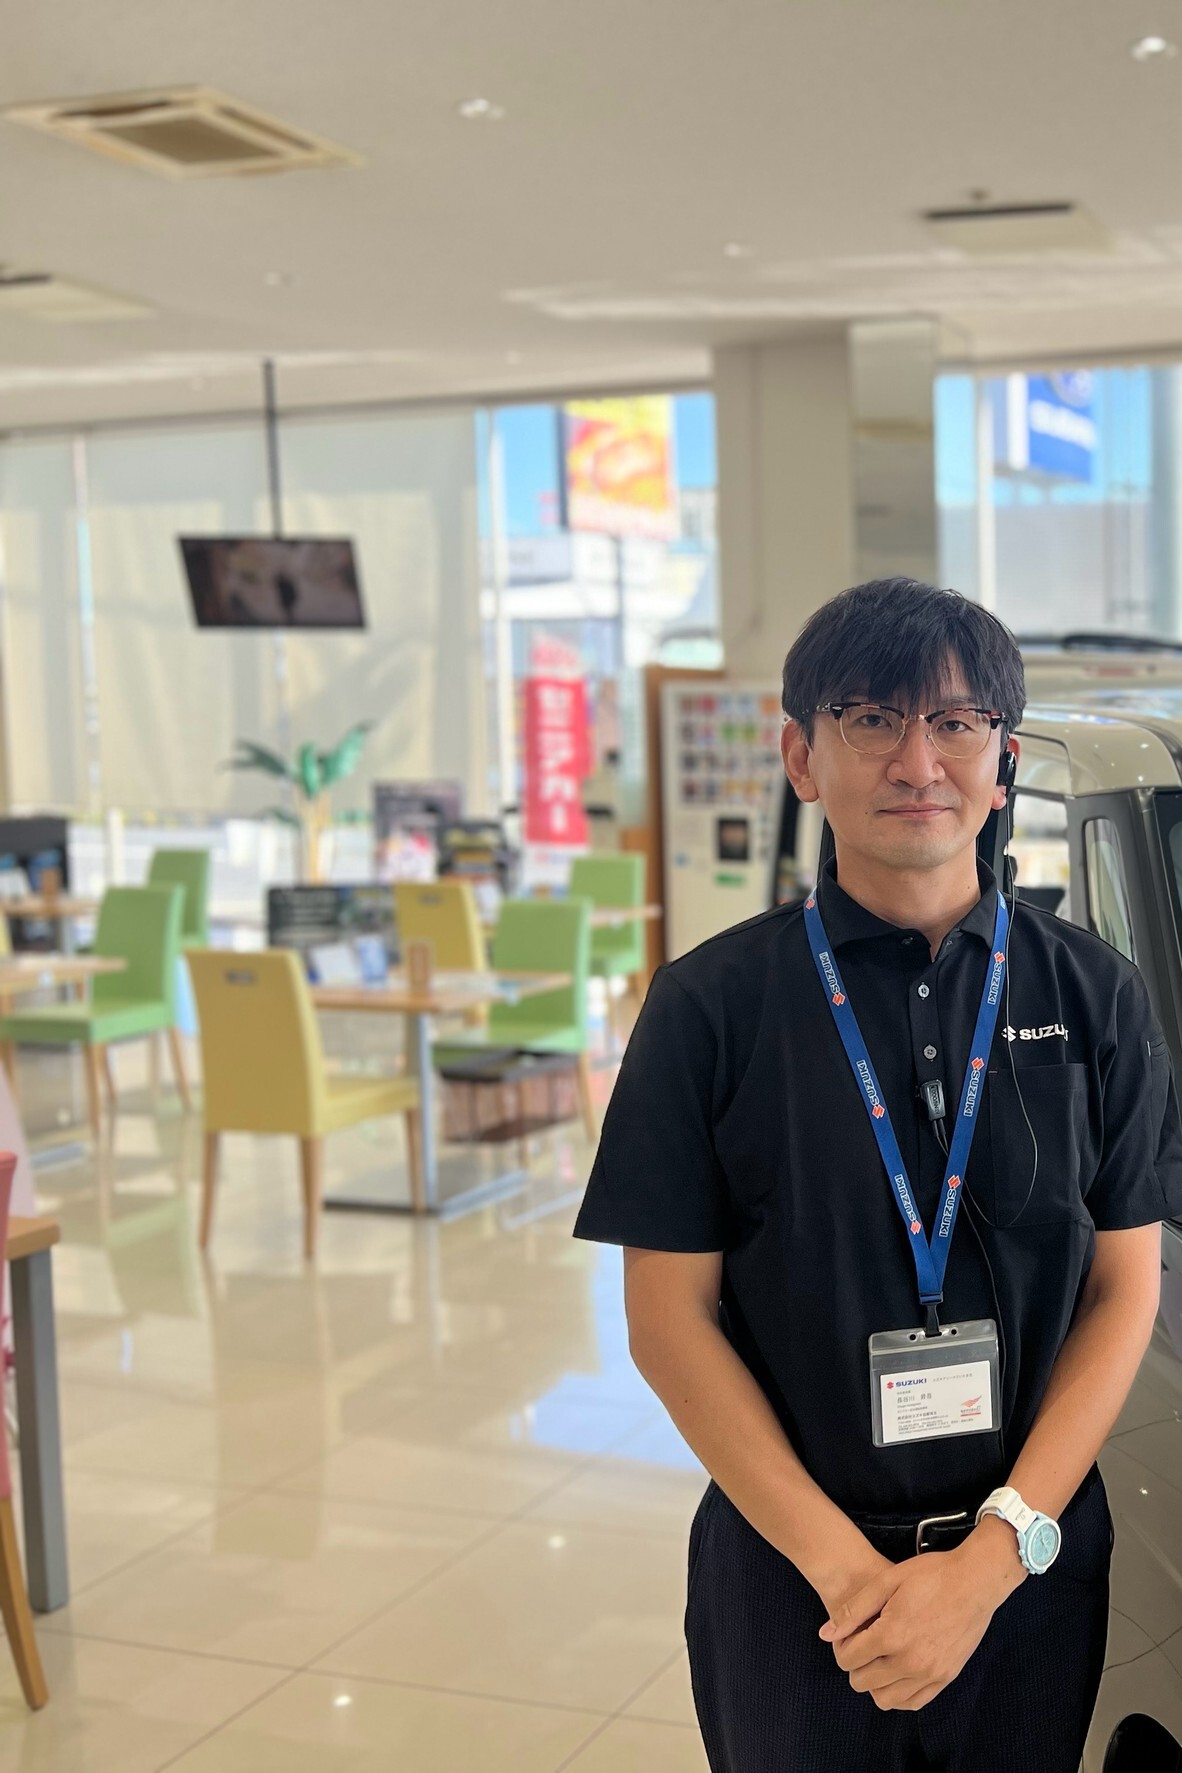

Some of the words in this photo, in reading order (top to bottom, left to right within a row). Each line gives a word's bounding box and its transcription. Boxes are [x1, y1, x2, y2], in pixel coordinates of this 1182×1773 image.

[819, 951, 840, 994] SUZUKI
[987, 961, 1002, 1005] SUZUKI
[1019, 1023, 1069, 1042] SUZU
[856, 1060, 880, 1106] SUZUKI
[963, 1070, 981, 1117] SUZUKI
[894, 1174, 917, 1222] SUZUKI
[939, 1188, 957, 1238] SUZUKI
[896, 1378, 927, 1387] SUZUKI
